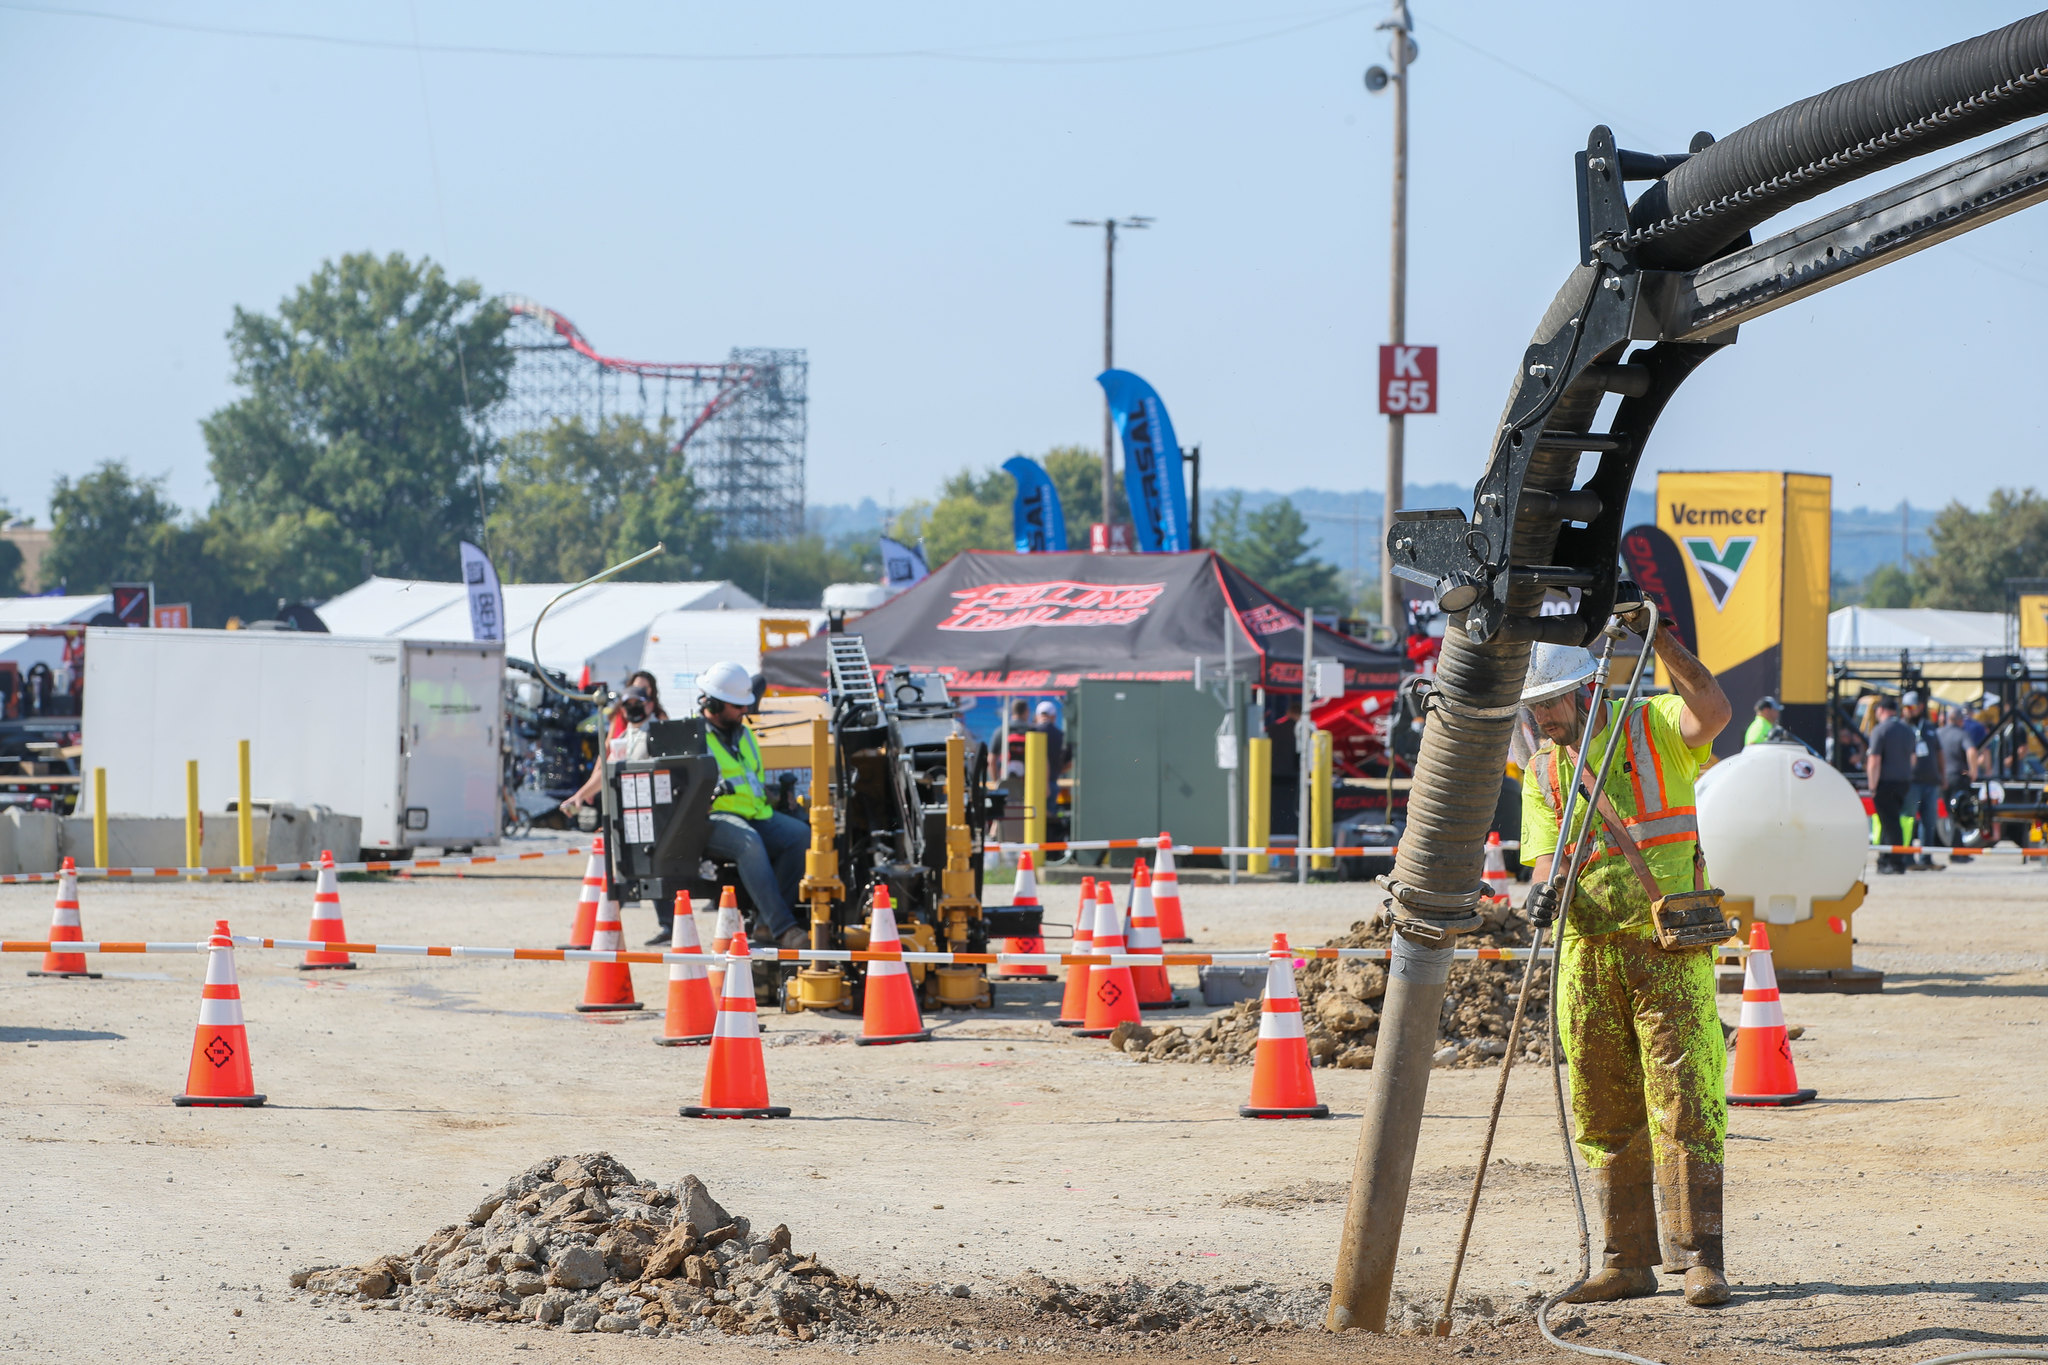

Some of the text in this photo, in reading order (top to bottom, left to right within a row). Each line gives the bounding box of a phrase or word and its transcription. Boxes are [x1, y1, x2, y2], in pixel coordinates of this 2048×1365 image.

[1394, 347, 1422, 378] K
[1387, 380, 1430, 411] 55
[1671, 503, 1766, 524] Vermeer
[951, 580, 1166, 609] FELLING
[937, 606, 1148, 631] TRAILERS
